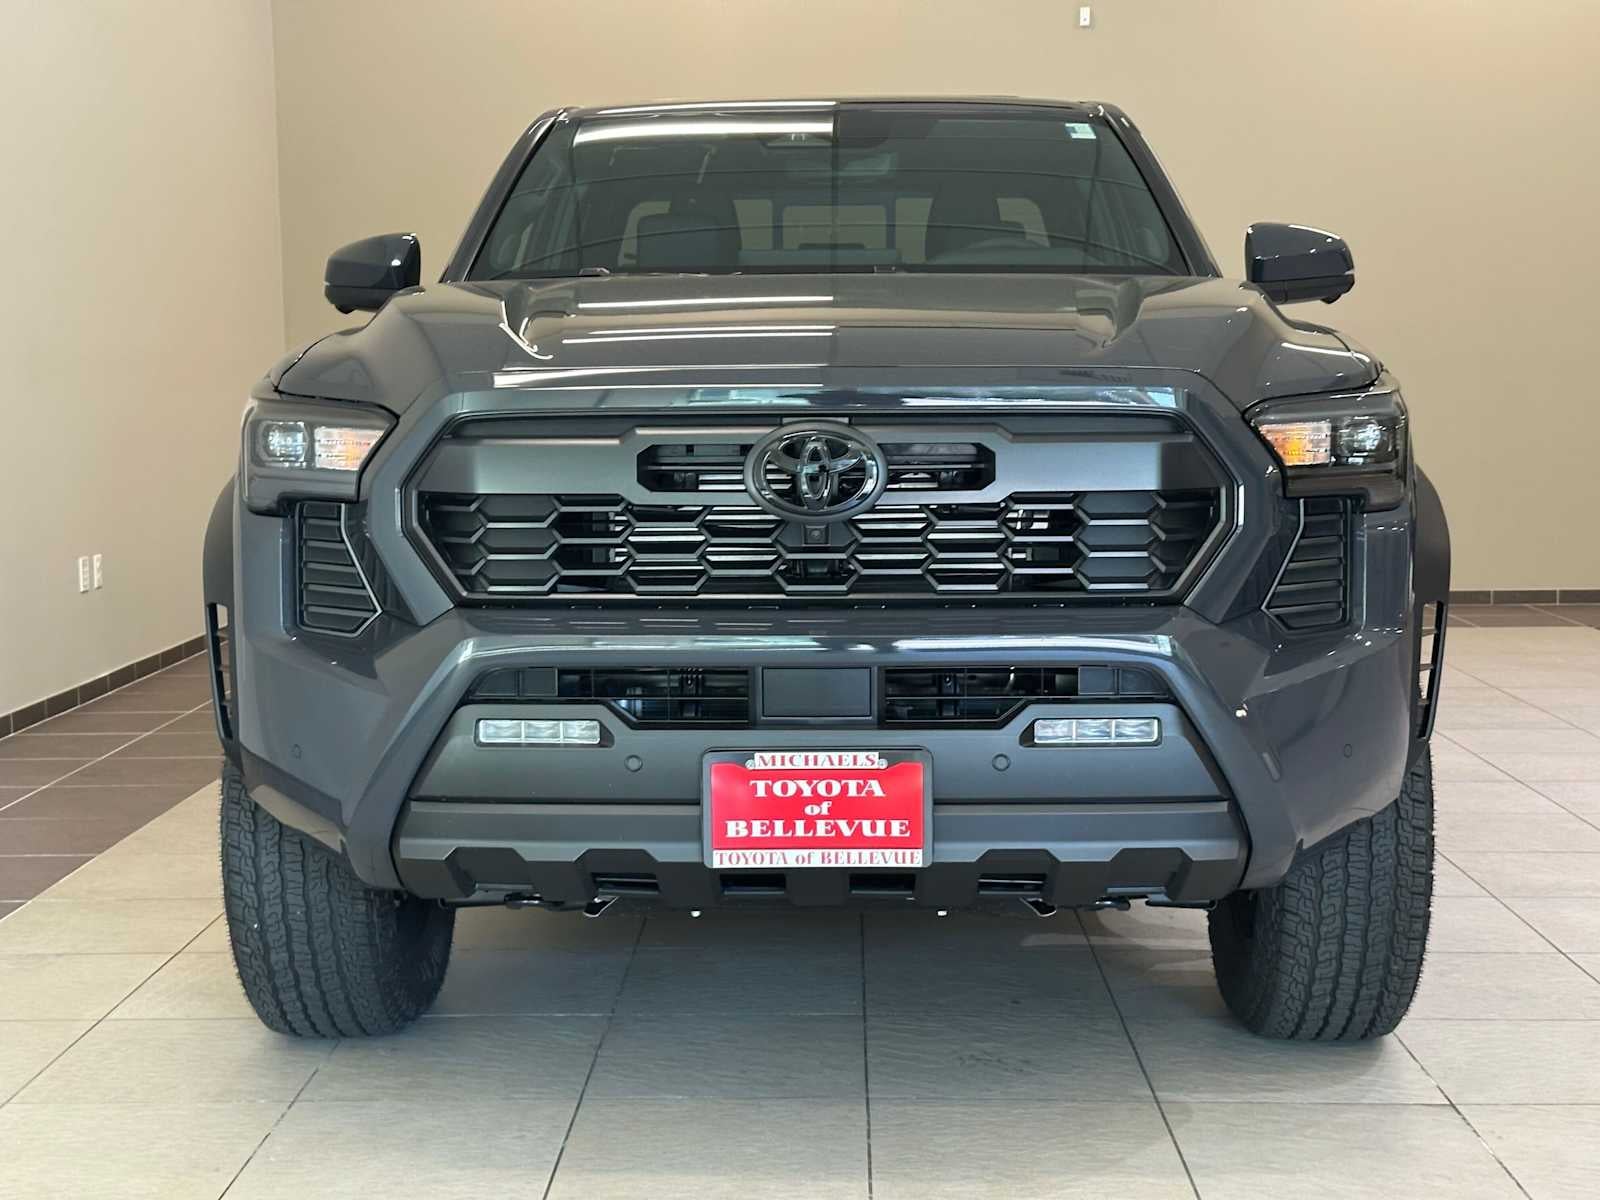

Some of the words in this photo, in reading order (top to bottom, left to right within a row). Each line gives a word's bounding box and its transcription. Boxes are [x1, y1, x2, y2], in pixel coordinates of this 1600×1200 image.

[758, 754, 877, 767] MICHAELS
[749, 779, 887, 798] TOYOTA
[804, 801, 832, 816] of
[725, 819, 911, 838] BELLEVUE
[715, 851, 788, 865] TOYOTA
[795, 851, 815, 865] of
[821, 851, 920, 865] BELLEVUE
